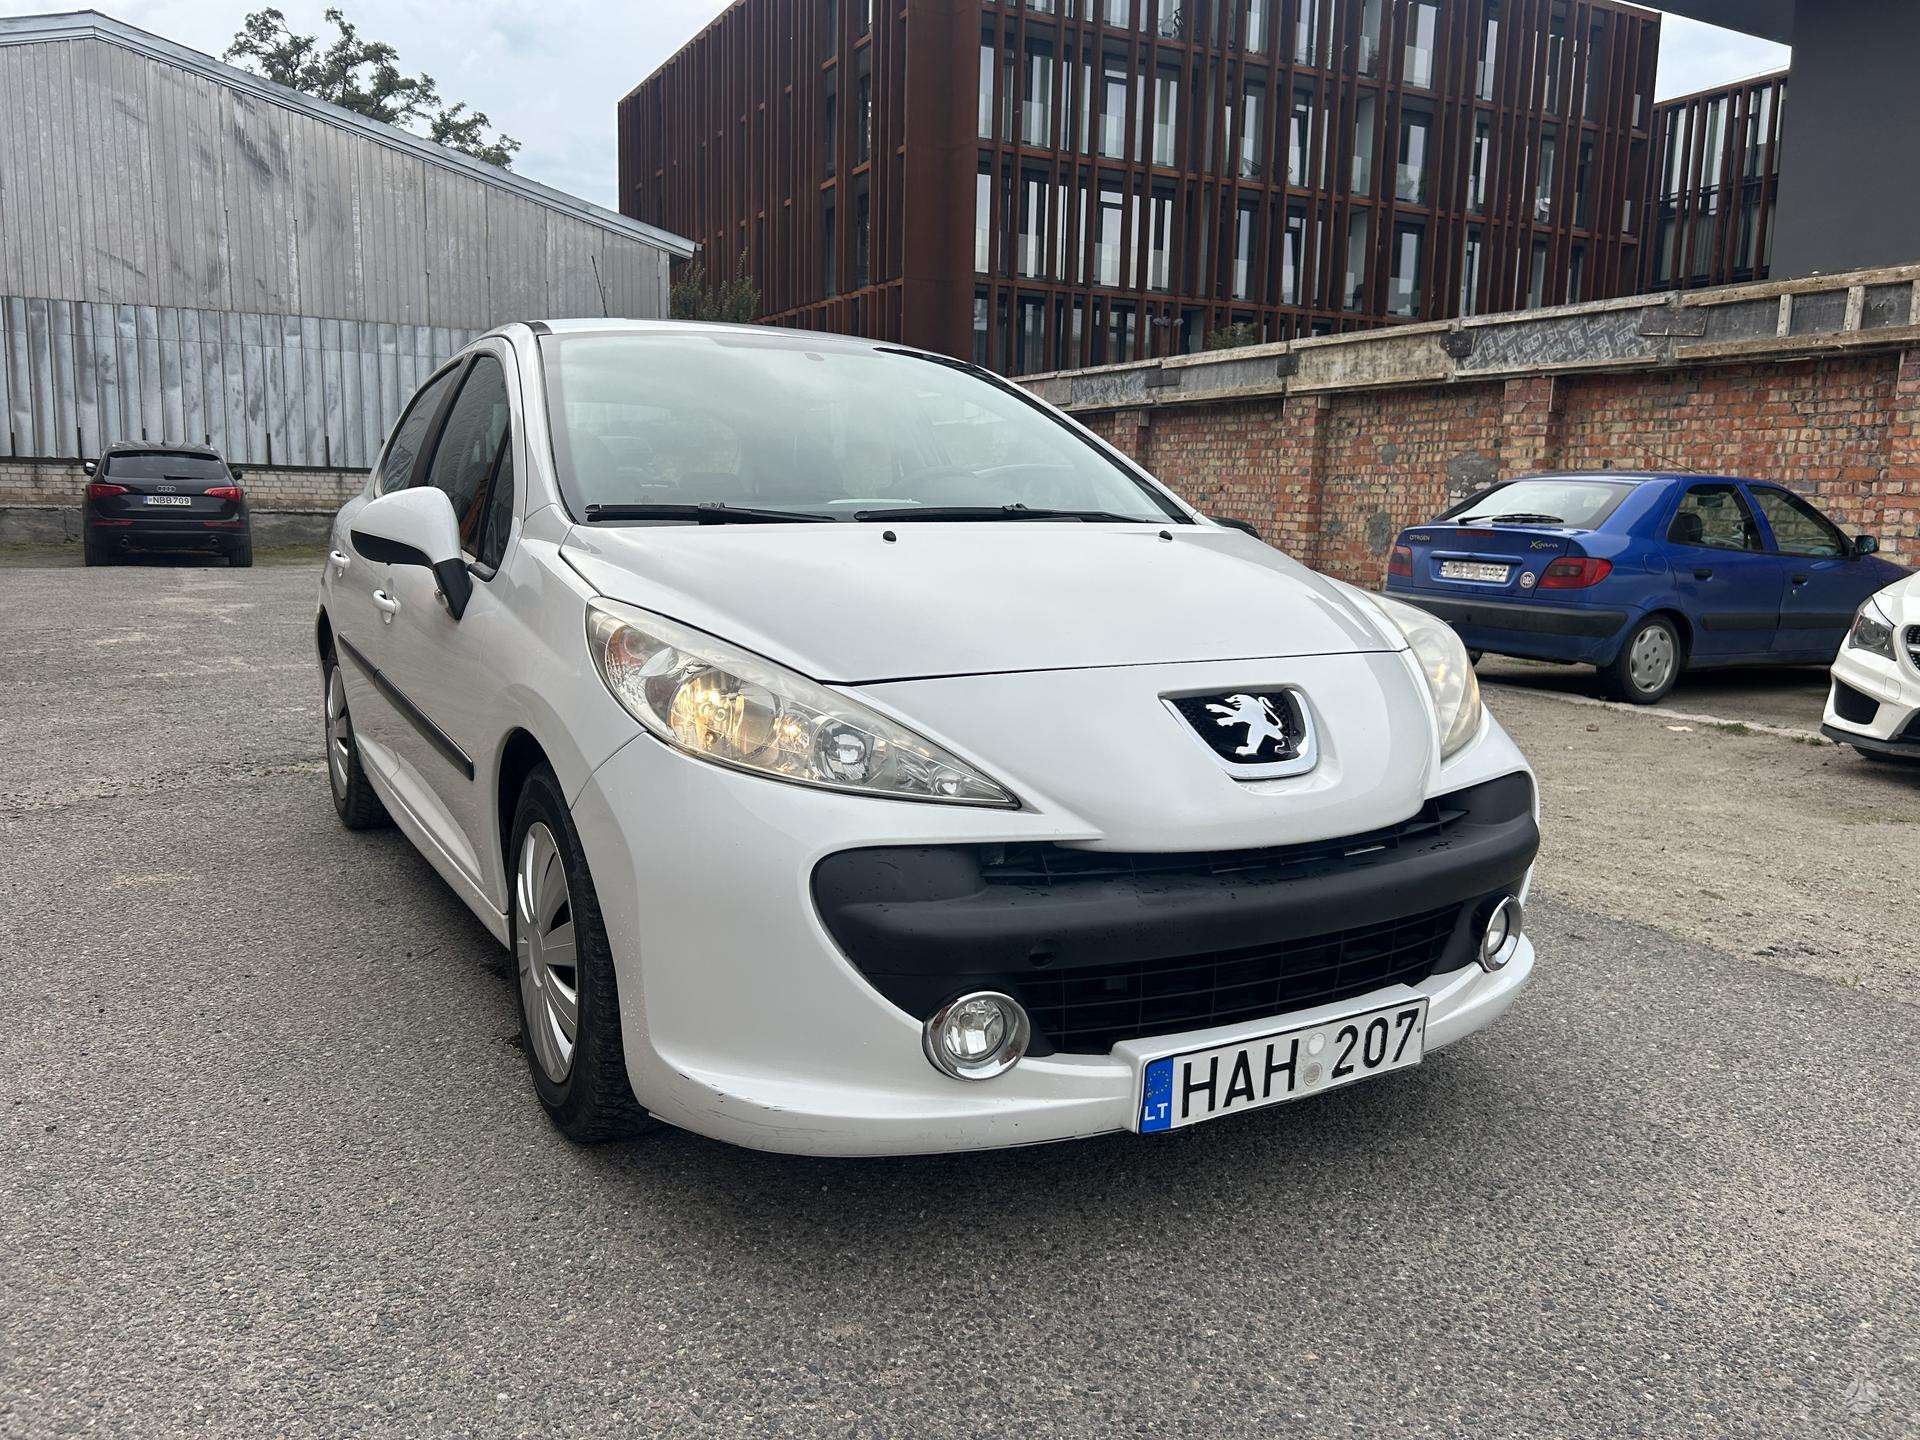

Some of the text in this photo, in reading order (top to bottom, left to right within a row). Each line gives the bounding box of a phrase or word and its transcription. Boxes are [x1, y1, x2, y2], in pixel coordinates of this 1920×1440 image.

[1181, 1007, 1420, 1118] HAH 207
[1143, 1102, 1169, 1121] LT
